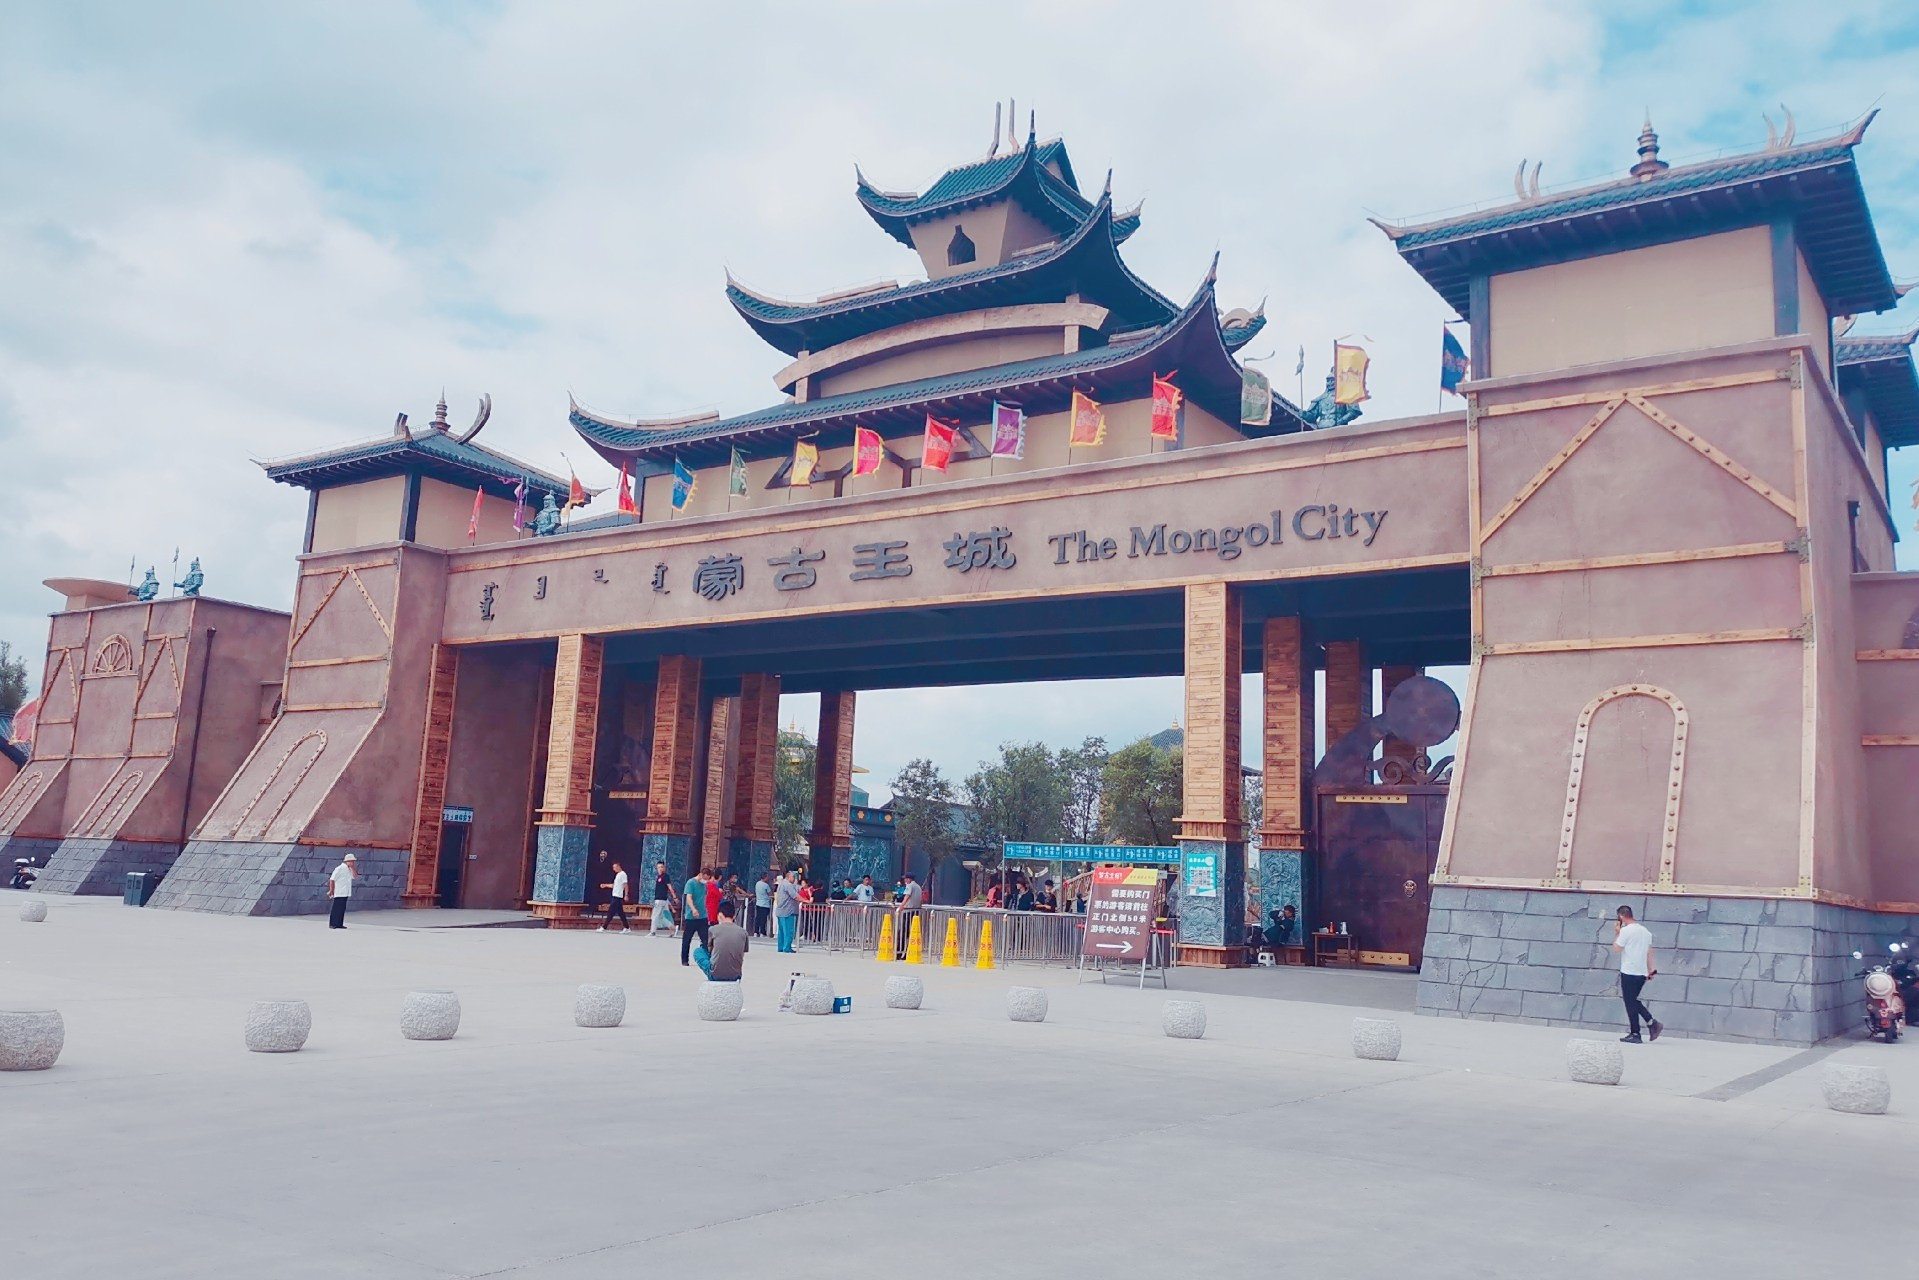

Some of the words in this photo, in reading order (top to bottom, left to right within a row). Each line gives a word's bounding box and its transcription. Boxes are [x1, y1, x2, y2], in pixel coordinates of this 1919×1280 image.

[692, 526, 1017, 601] 蒙古王城
[1048, 529, 1117, 565] The
[1127, 510, 1284, 561] Mongol
[1292, 503, 1389, 547] City
